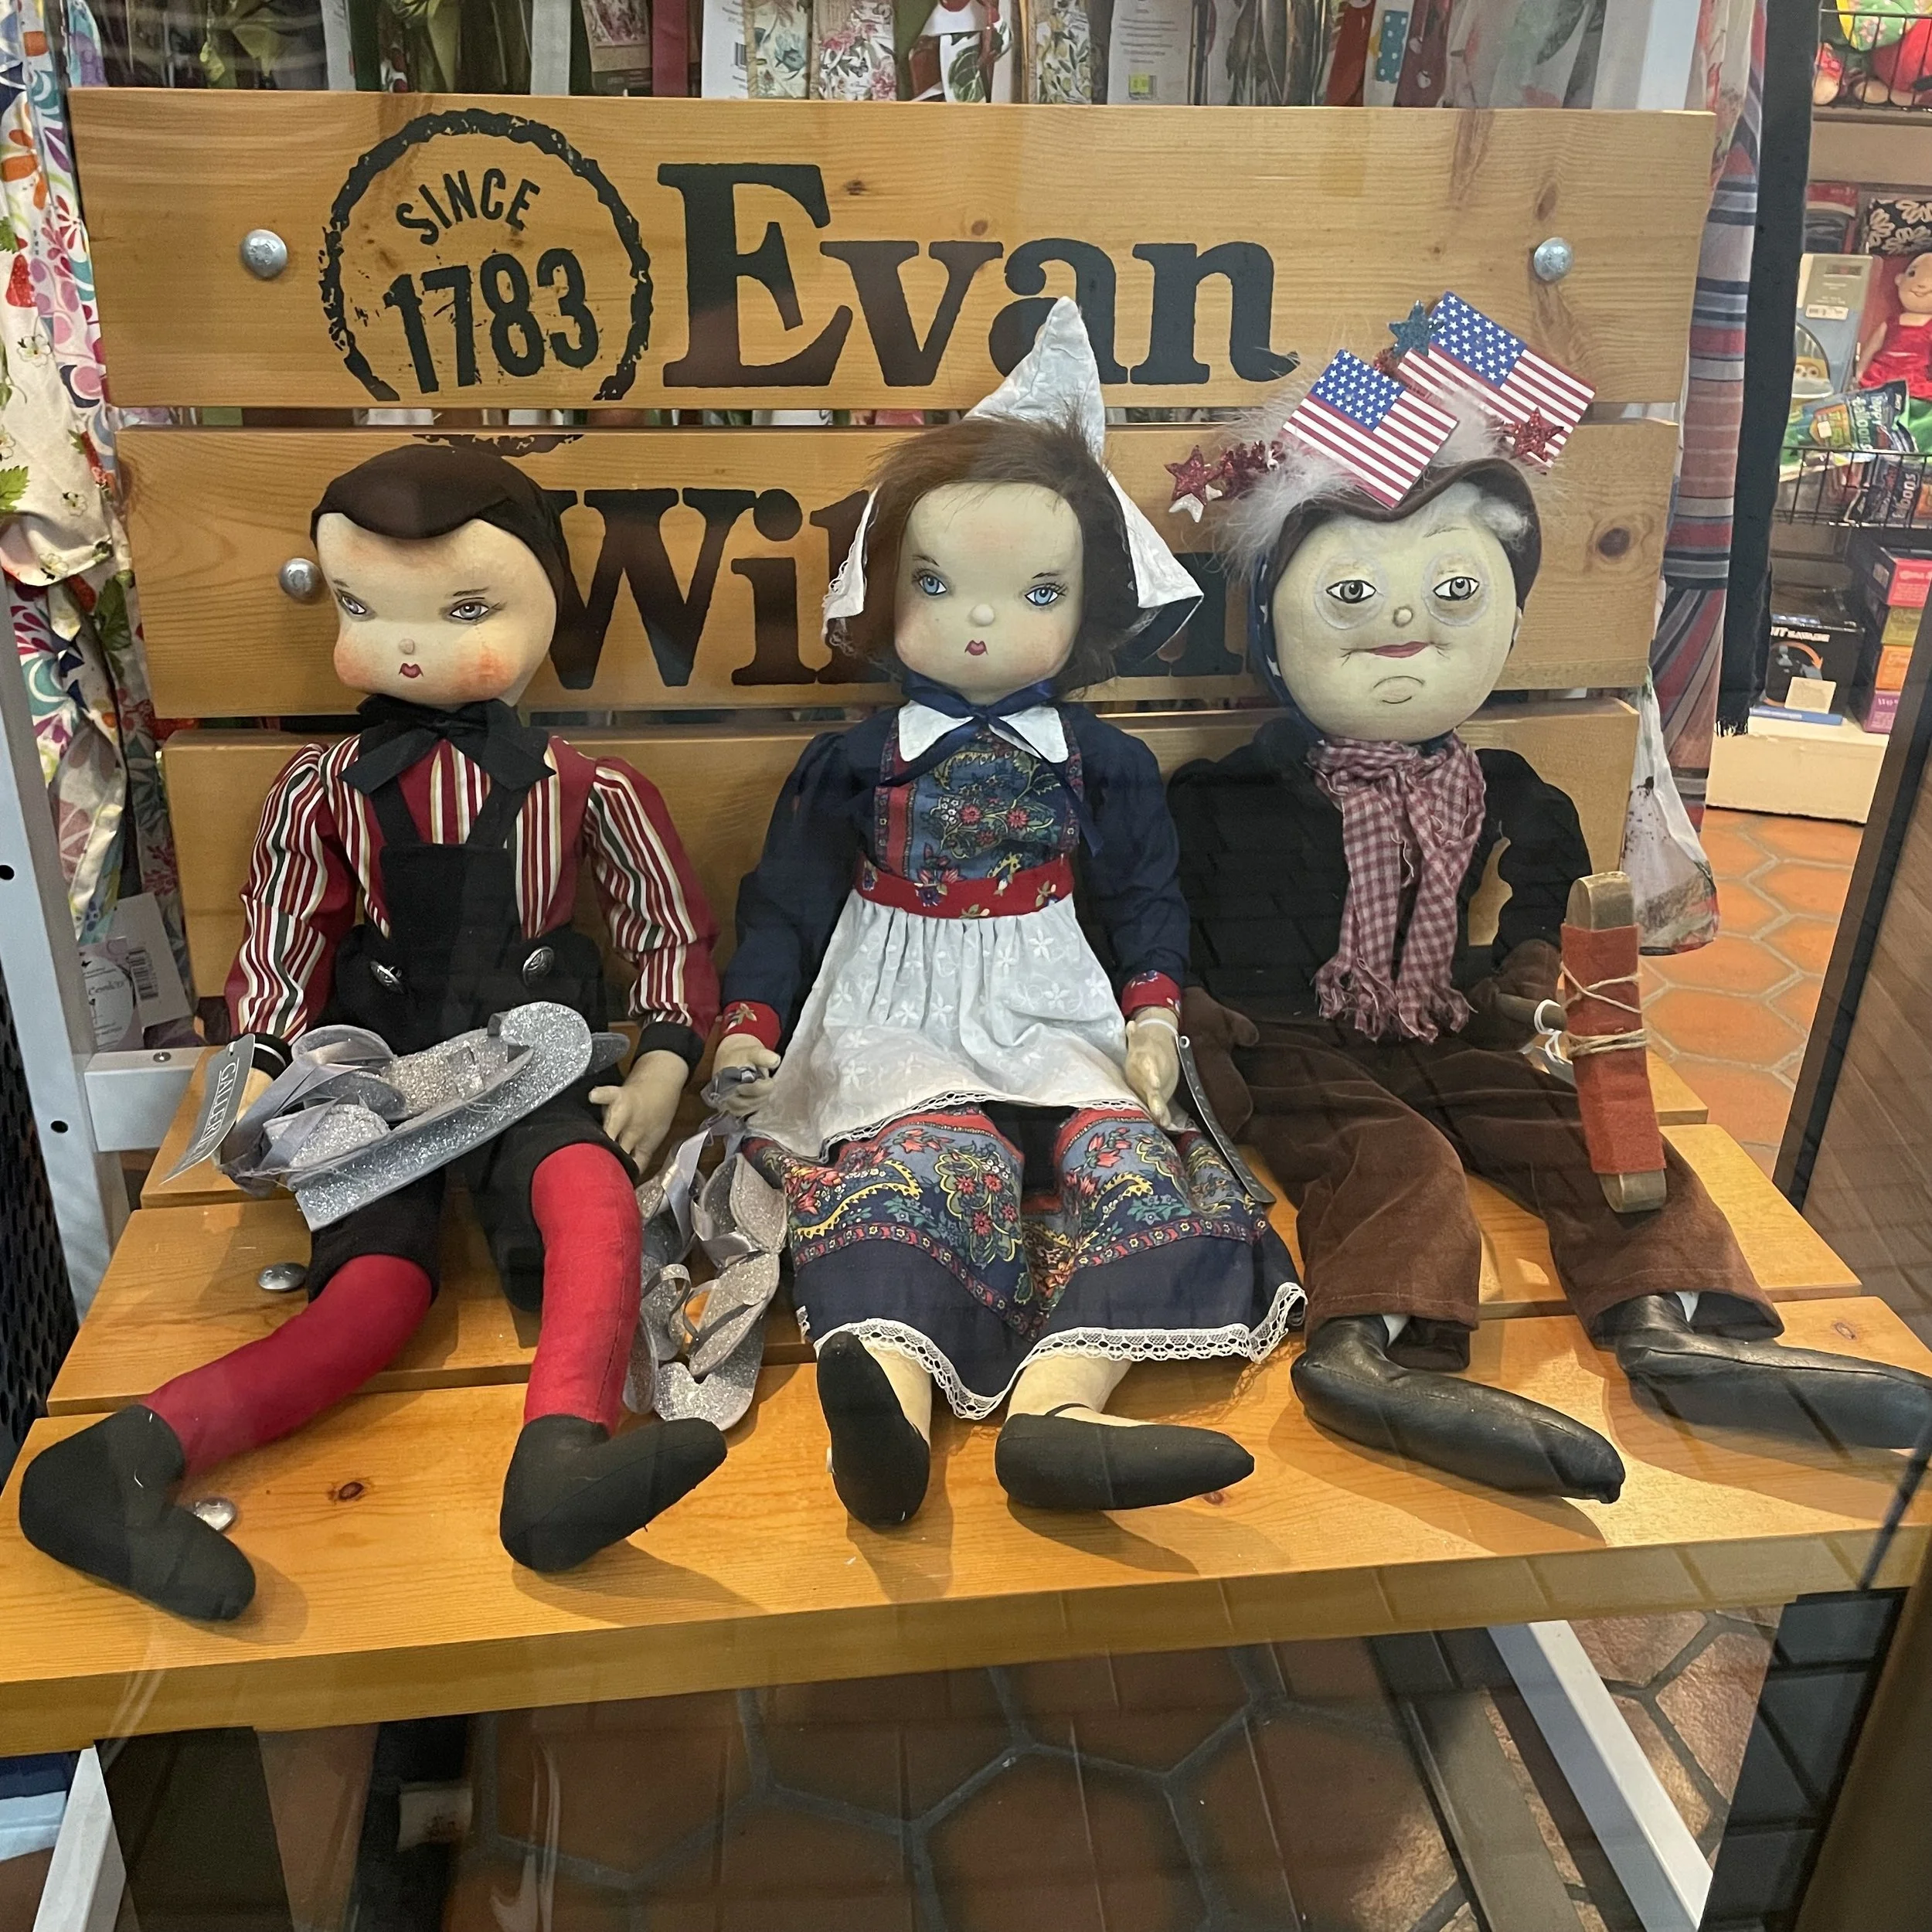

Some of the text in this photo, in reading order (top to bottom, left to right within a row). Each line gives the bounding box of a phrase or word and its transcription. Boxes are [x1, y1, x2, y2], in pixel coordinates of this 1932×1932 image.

[395, 168, 541, 247] SINCE
[658, 162, 1301, 388] Evan
[383, 247, 600, 395] 1783
